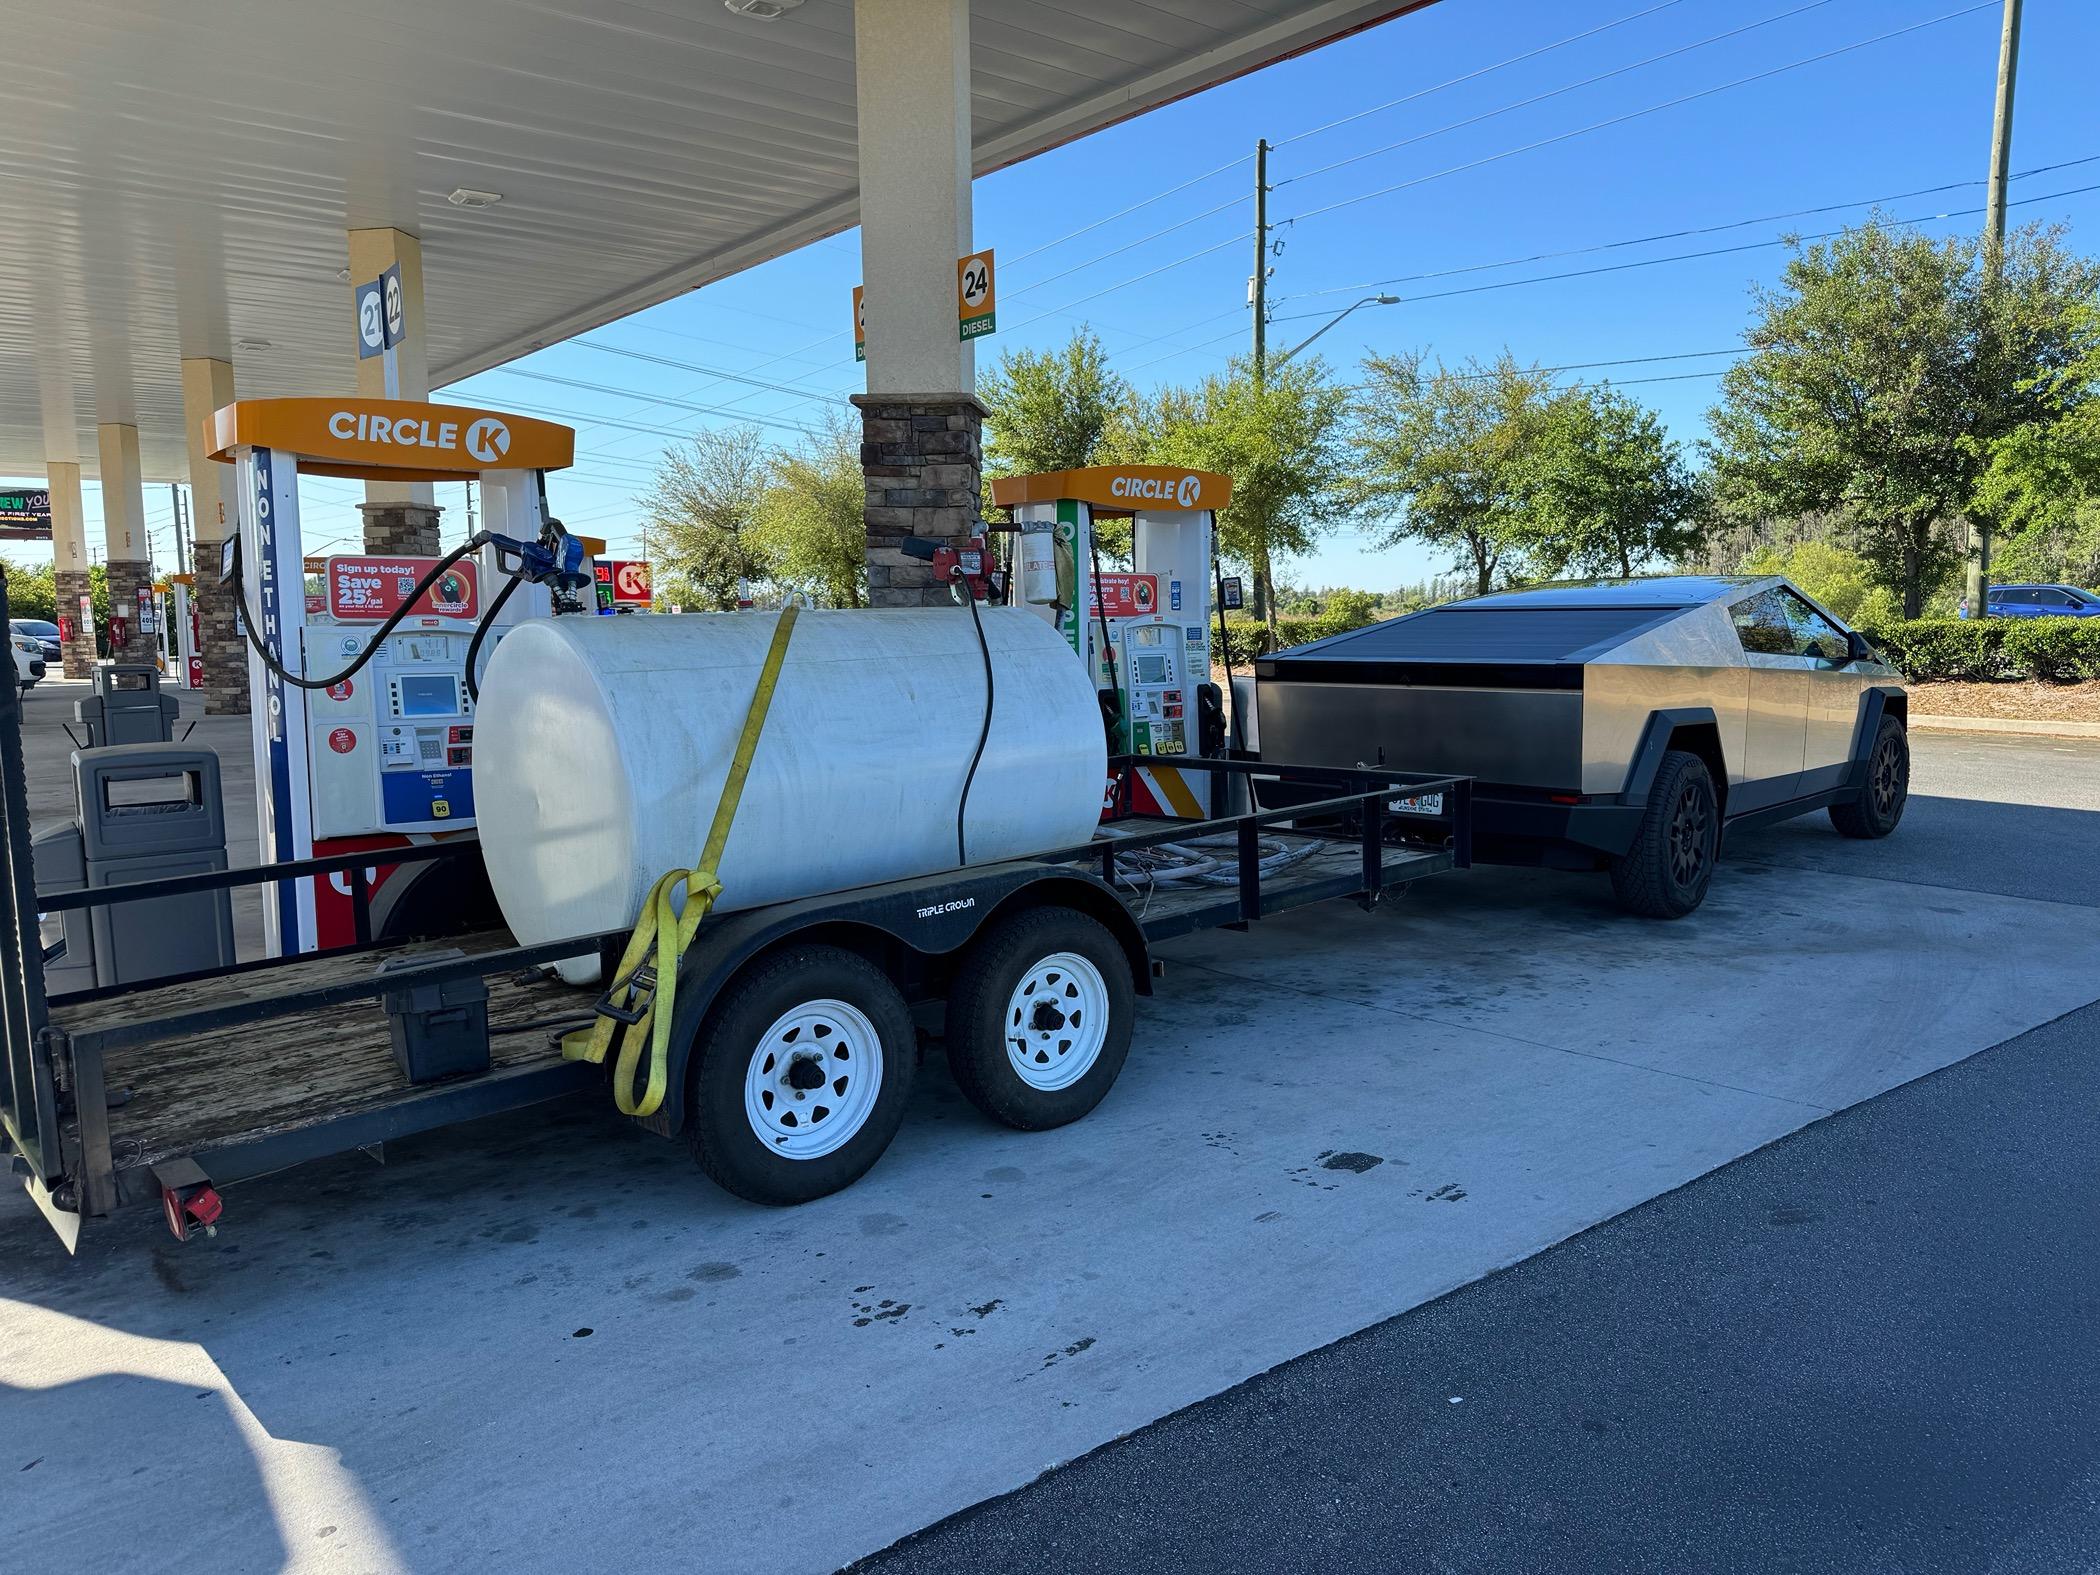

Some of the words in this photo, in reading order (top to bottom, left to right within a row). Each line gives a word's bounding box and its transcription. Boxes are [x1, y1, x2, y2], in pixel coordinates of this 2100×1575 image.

[965, 267, 987, 299] 24
[388, 287, 400, 324] 22
[364, 302, 382, 336] 21
[962, 318, 993, 336] DIESEL
[329, 412, 458, 449] CIRCLE
[470, 420, 507, 461] K
[1112, 477, 1175, 499] CIRCLE
[1179, 477, 1199, 506] K
[257, 469, 271, 546] NON
[337, 564, 362, 574] Sign
[363, 566, 378, 574] up
[380, 566, 415, 574] today!
[338, 575, 382, 589] Save
[621, 568, 645, 594] K
[193, 660, 202, 669] K
[436, 805, 447, 813] 90
[916, 904, 945, 918] TRIPLE
[945, 898, 975, 912] CROWN
